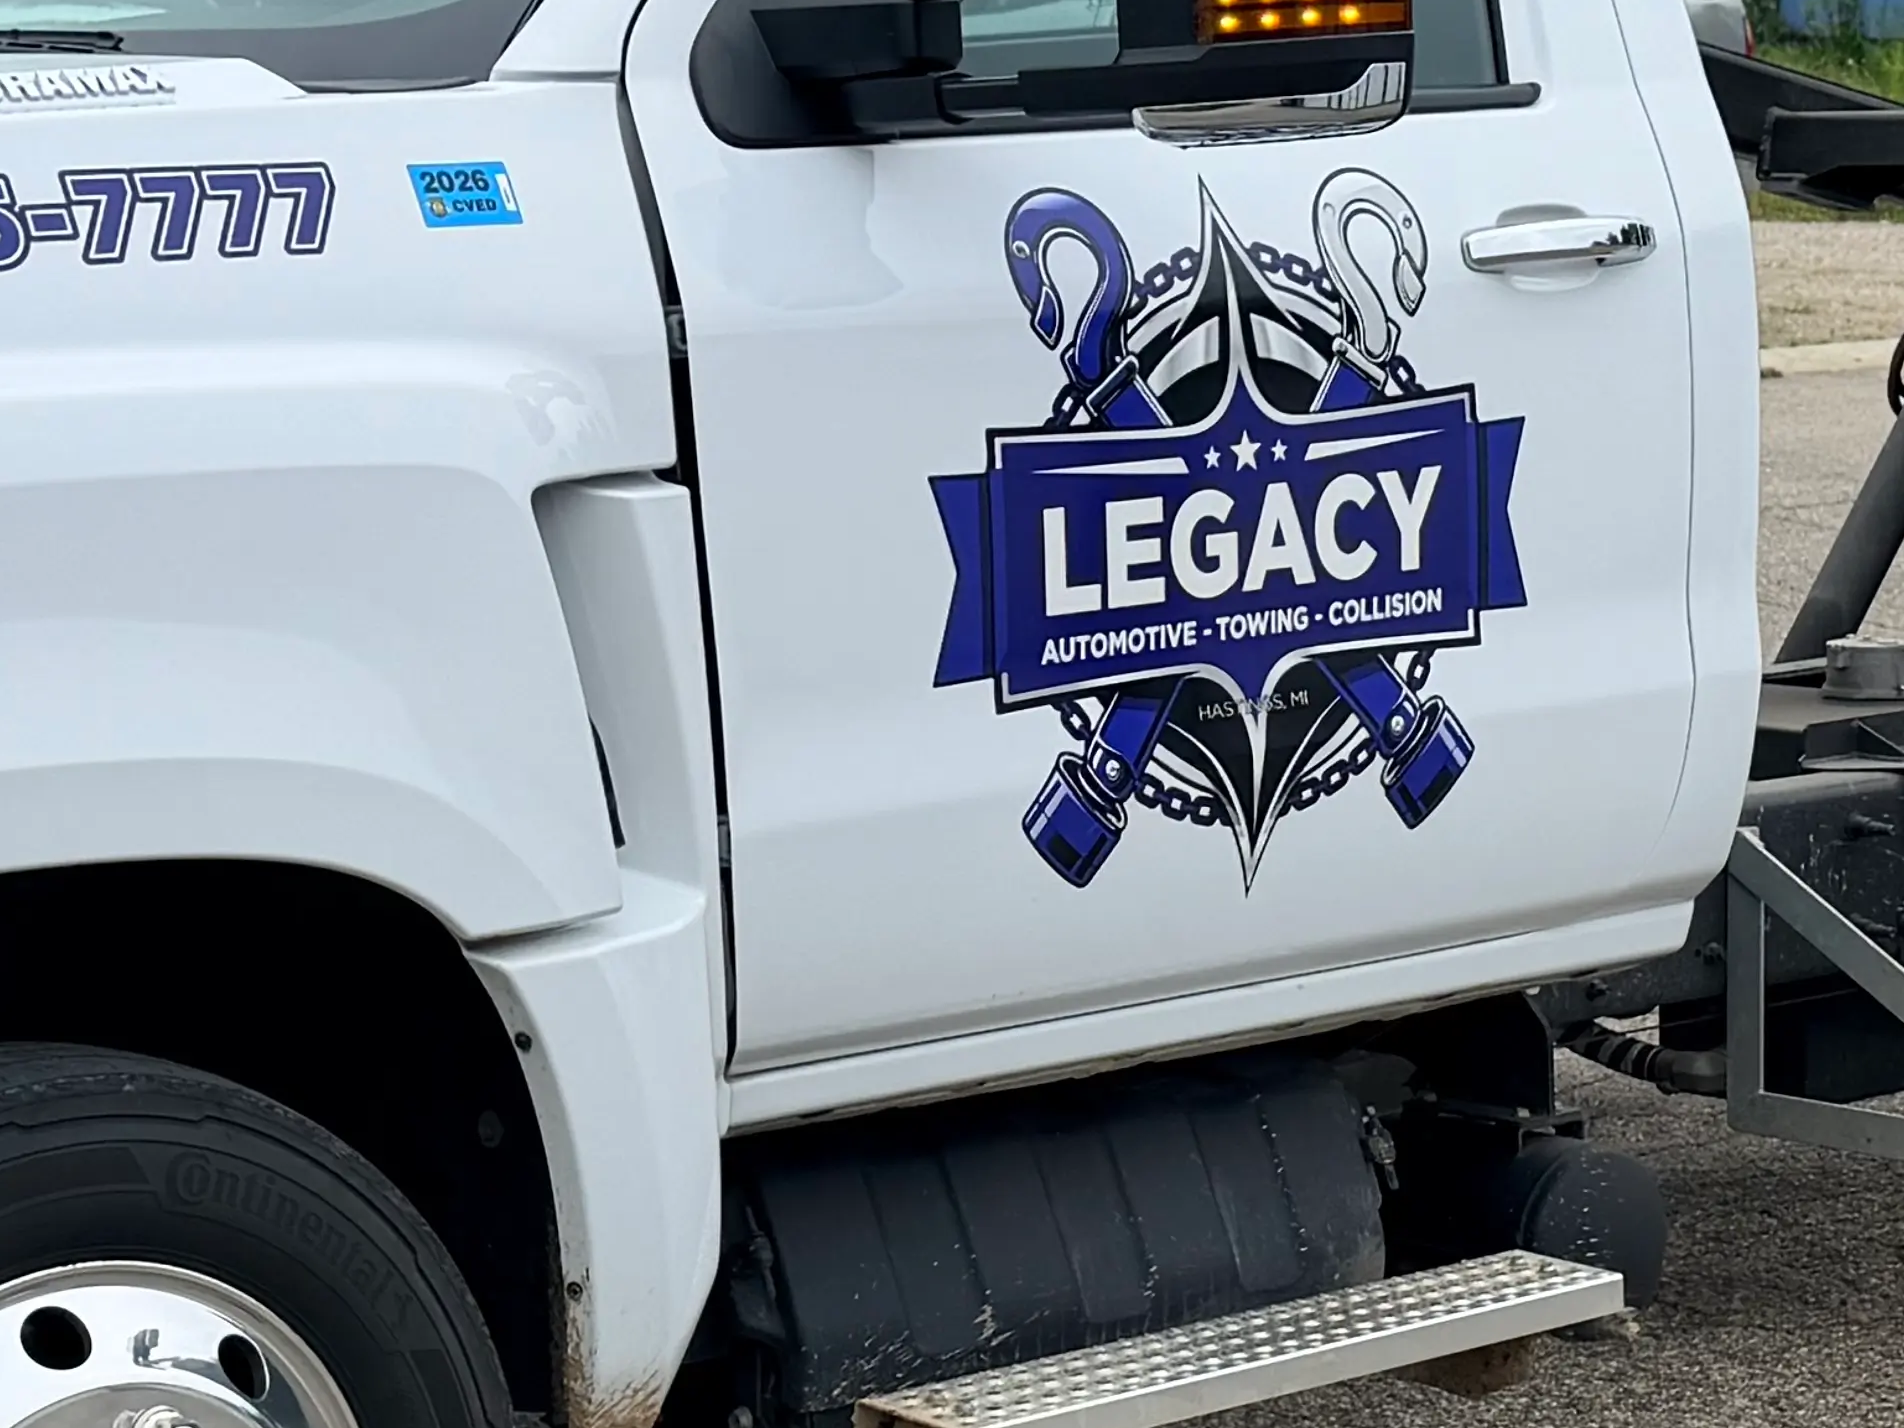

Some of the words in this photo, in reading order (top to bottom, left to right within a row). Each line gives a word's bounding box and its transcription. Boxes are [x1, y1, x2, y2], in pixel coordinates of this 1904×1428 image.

[419, 169, 490, 194] 2026
[452, 198, 497, 213] CVED
[1042, 464, 1442, 618] LEGACY
[1040, 619, 1197, 667] AUTOMOTIVE
[1215, 605, 1310, 641] TOWING
[1328, 586, 1443, 626] COLLISION
[1290, 689, 1310, 708] MI
[165, 1150, 395, 1311] Continental
